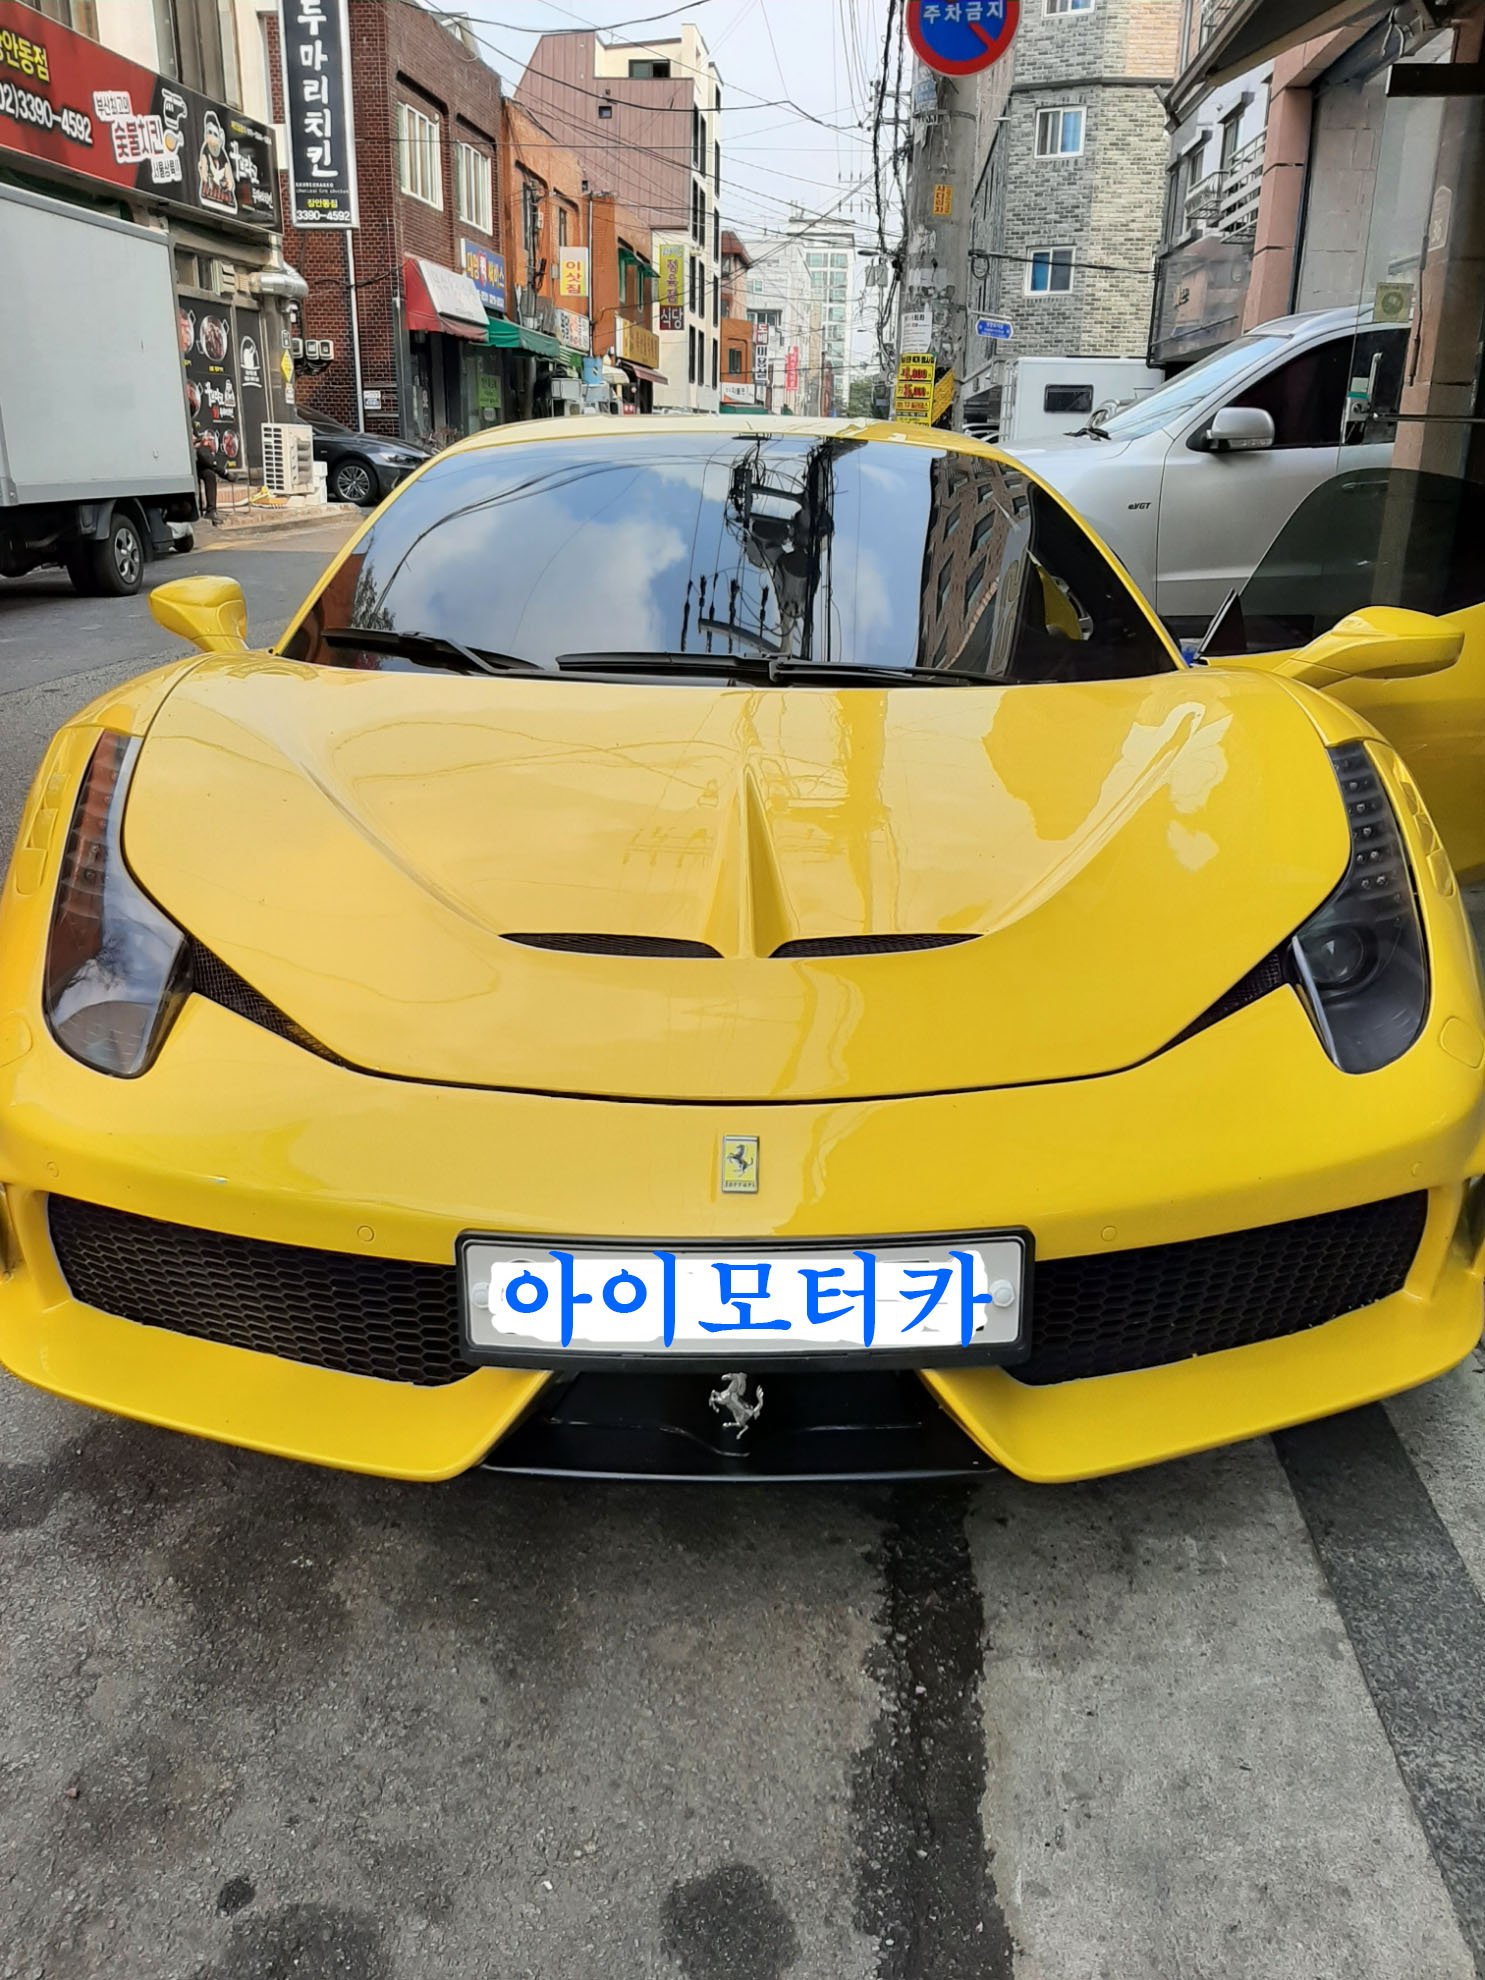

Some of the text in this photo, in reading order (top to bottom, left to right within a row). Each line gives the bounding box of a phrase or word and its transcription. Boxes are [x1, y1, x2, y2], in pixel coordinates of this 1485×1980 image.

[923, 1, 1004, 24] 주차금지
[296, 210, 351, 221] 3390-4592
[565, 260, 582, 295] 이삿짐
[660, 306, 684, 329] 식당
